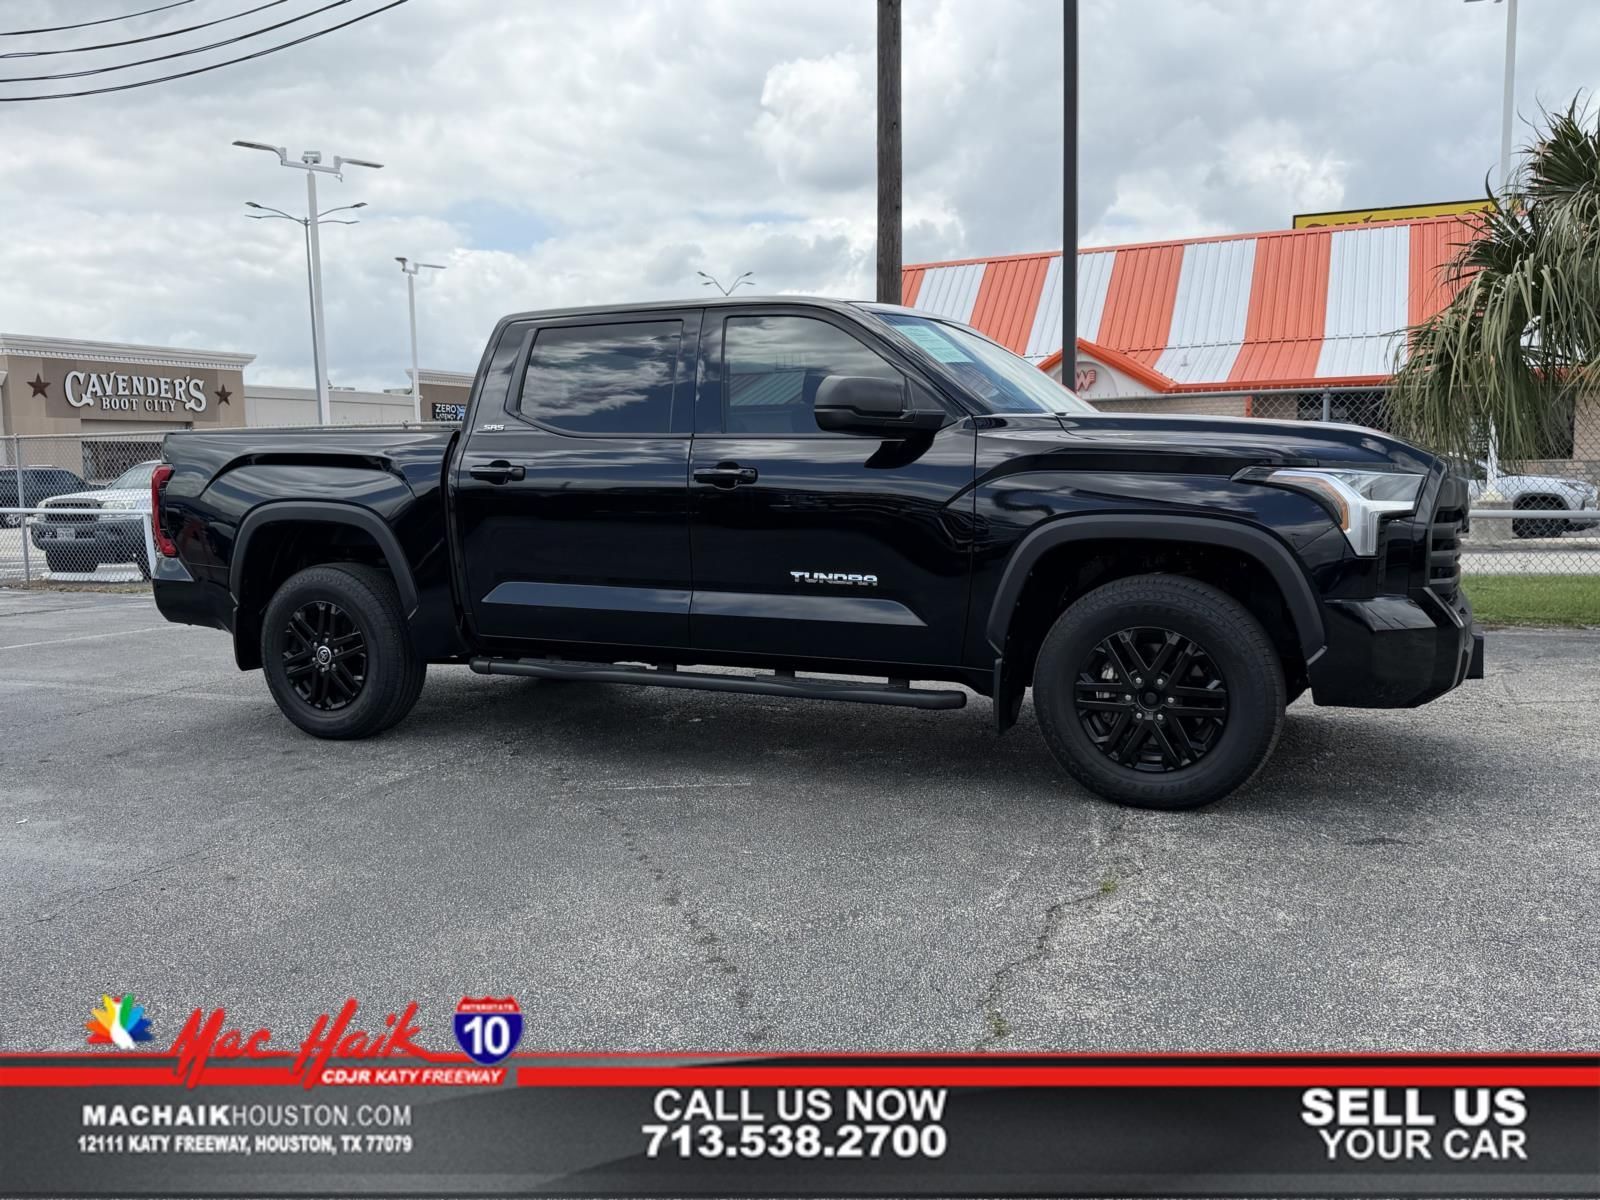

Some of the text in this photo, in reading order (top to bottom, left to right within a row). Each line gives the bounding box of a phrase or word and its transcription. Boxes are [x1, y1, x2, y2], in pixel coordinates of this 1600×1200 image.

[65, 371, 206, 412] CAVENDER'S
[103, 397, 176, 412] BOOT CITY
[435, 404, 457, 413] ZERO
[790, 571, 878, 586] TUNDRA
